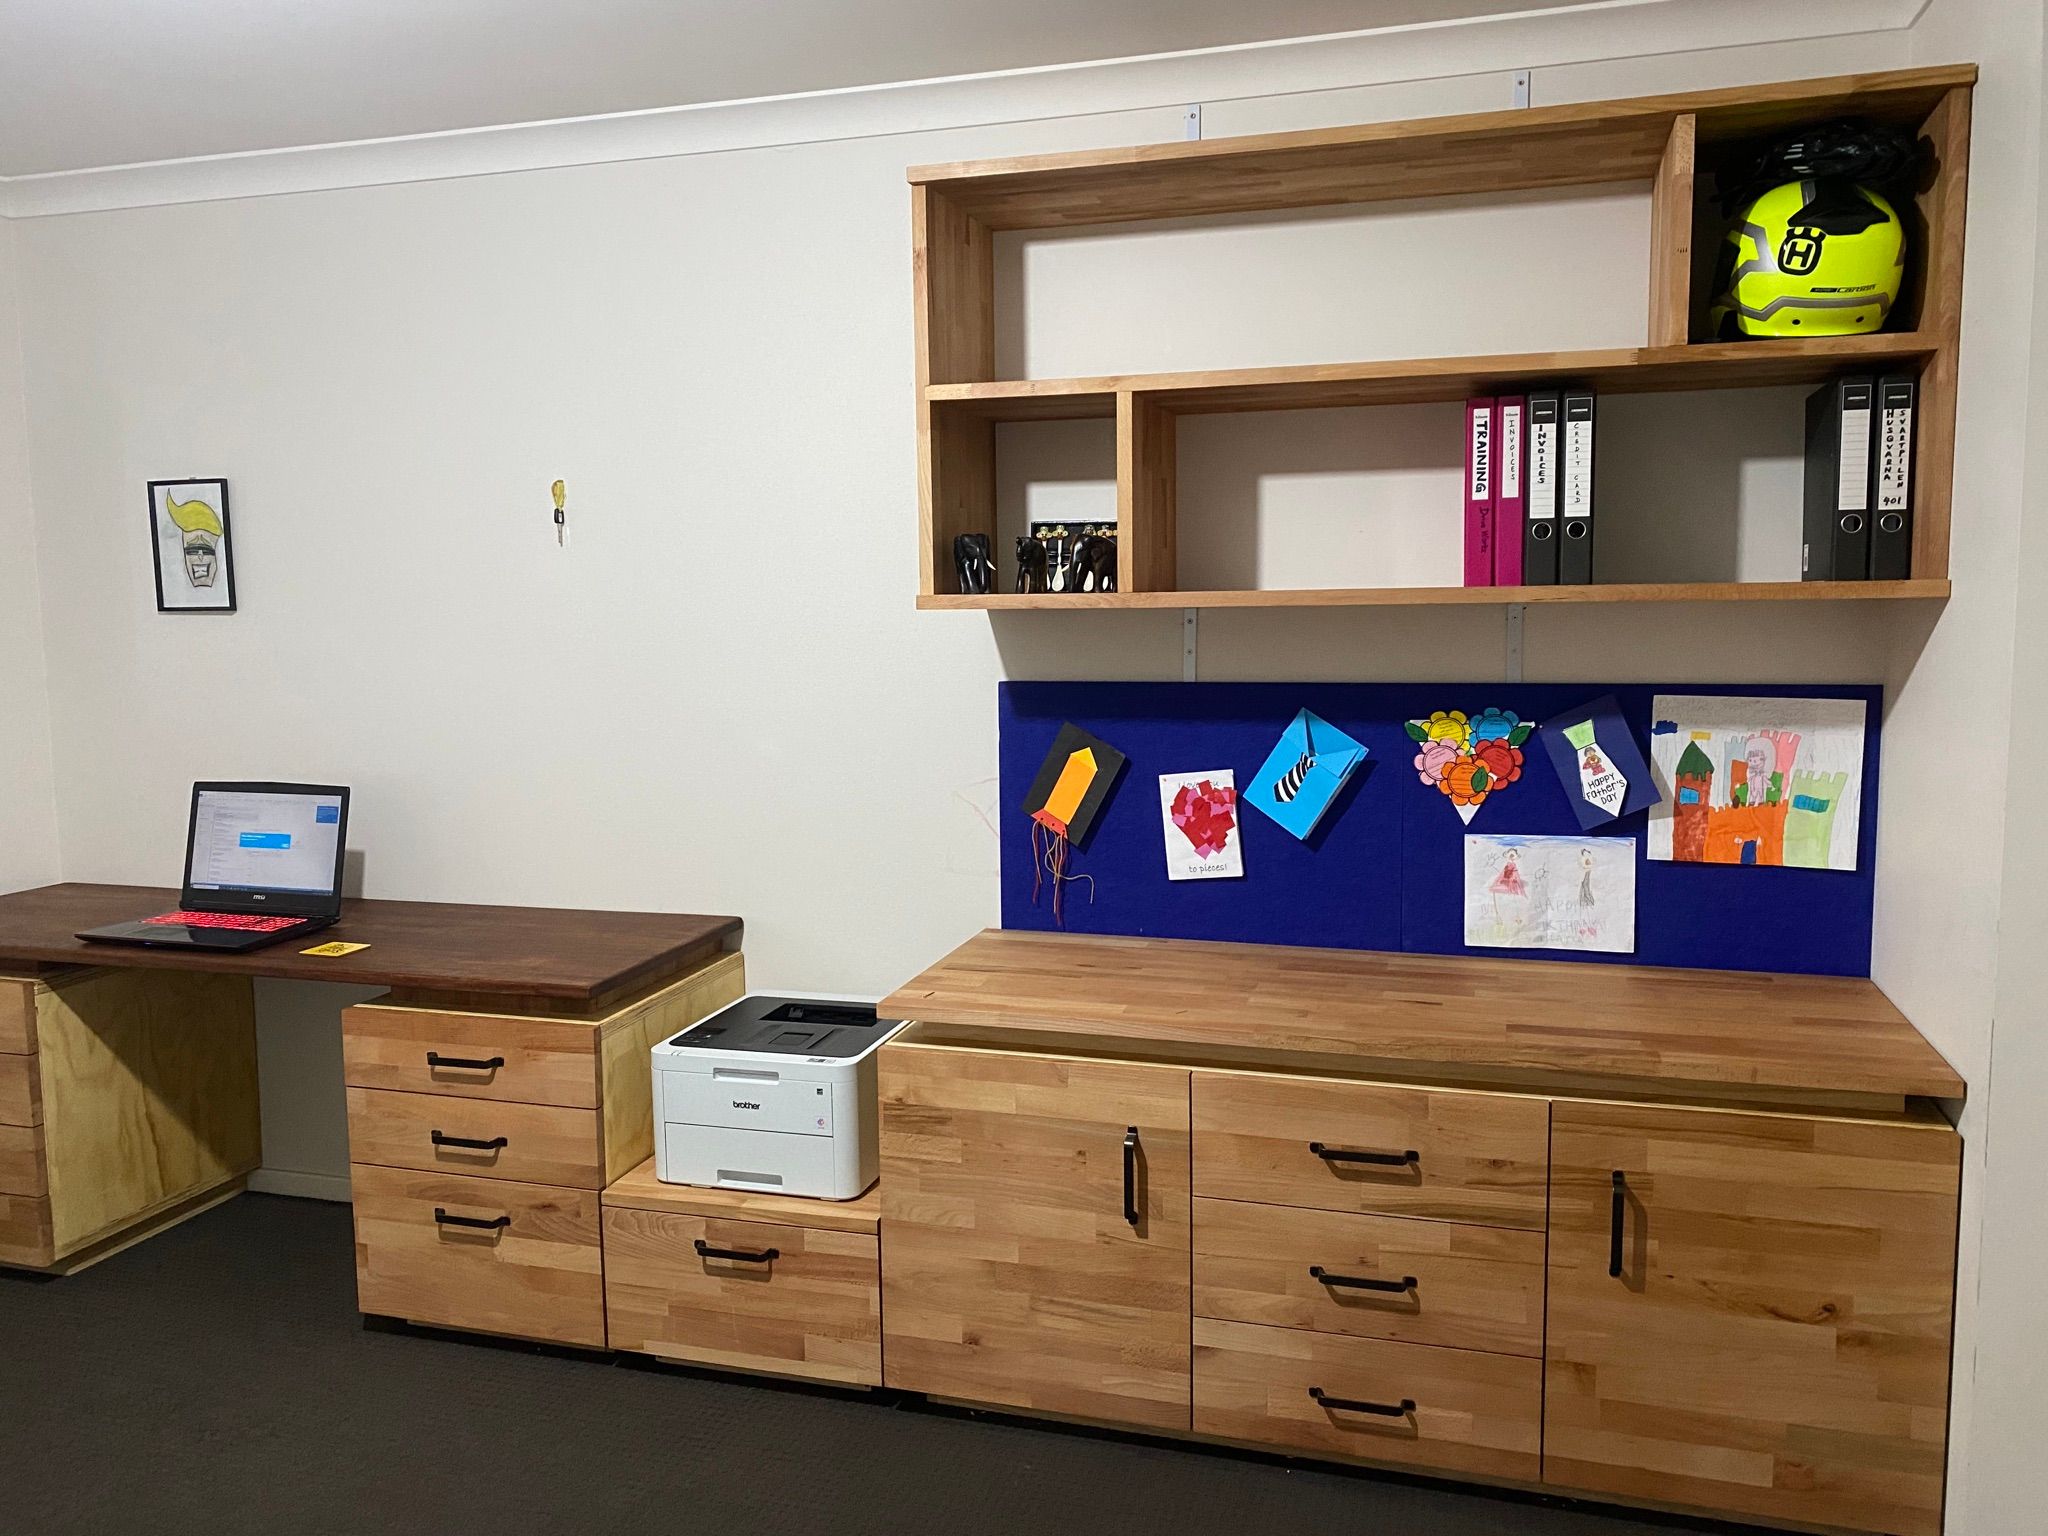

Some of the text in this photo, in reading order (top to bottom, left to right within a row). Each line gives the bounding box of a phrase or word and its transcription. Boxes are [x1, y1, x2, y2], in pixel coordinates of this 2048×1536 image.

[1476, 420, 1488, 493] TRAINING
[1537, 424, 1546, 484] INVOICES
[1884, 409, 1894, 480] HUSQVARNA
[1897, 409, 1906, 488] SVARTPILEN
[1883, 496, 1902, 506] 401
[1189, 863, 1228, 875] to pieces!
[732, 1100, 761, 1110] brother
